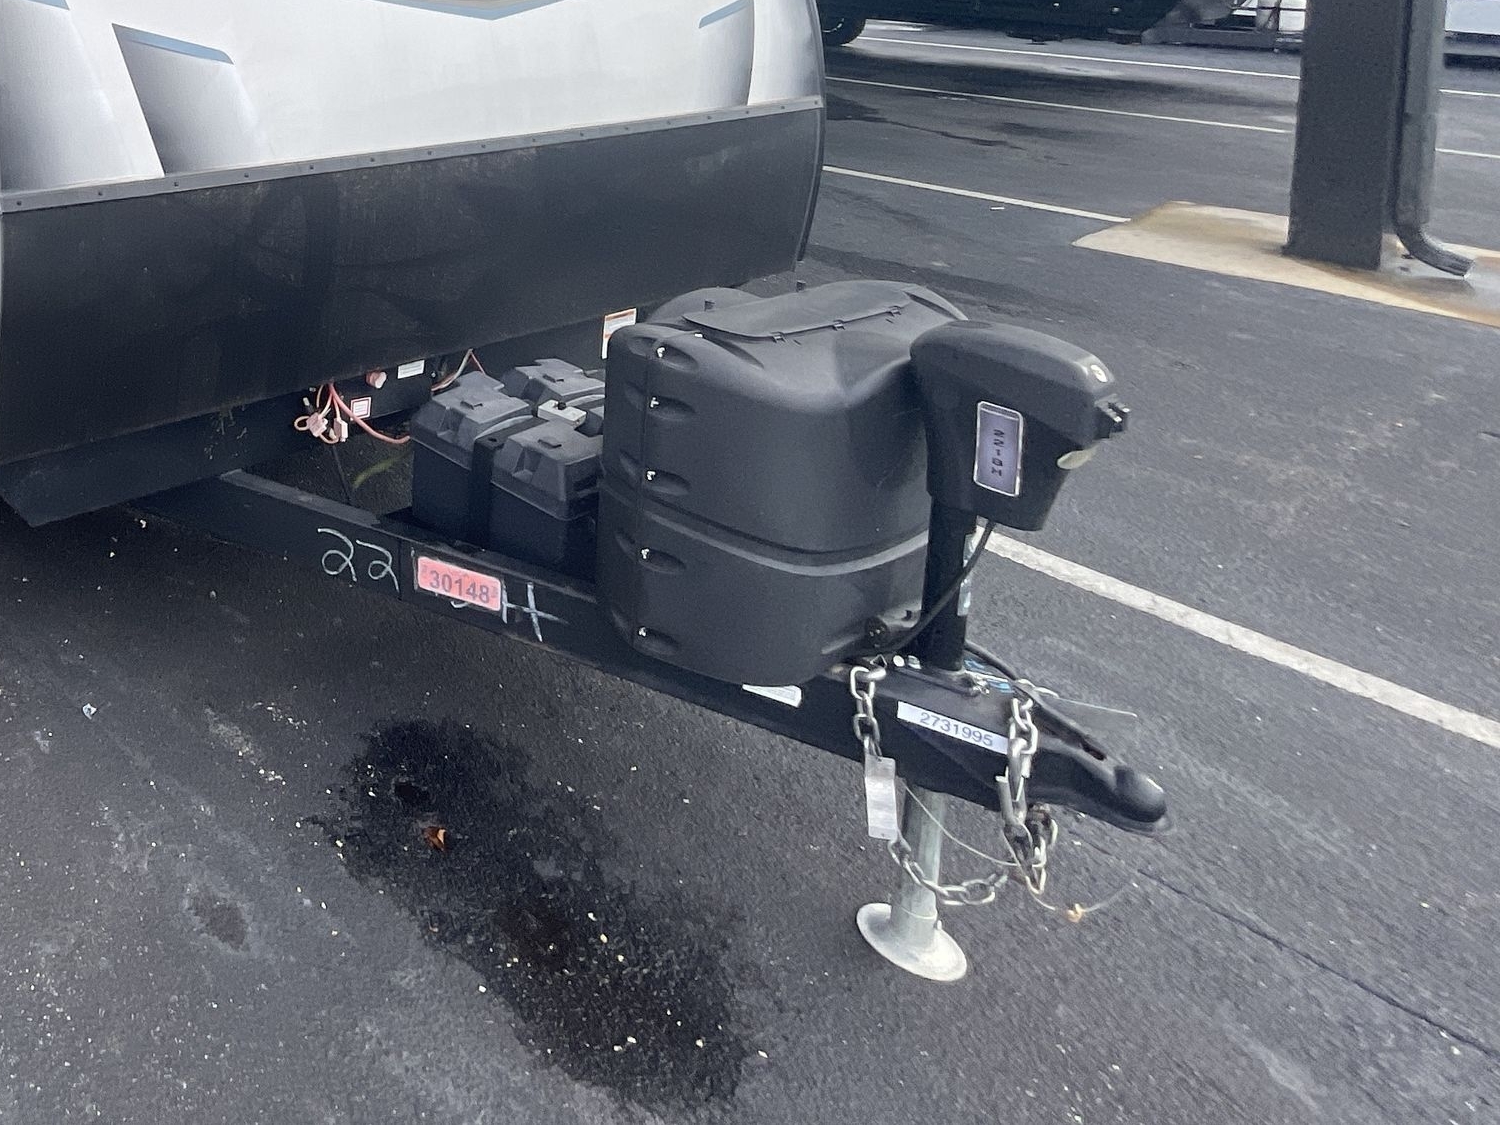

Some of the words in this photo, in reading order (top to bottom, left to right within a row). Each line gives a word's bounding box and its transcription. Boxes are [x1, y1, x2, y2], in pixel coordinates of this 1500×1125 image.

[317, 527, 400, 593] 22
[429, 570, 490, 604] 30148
[919, 711, 993, 747] 2731995
